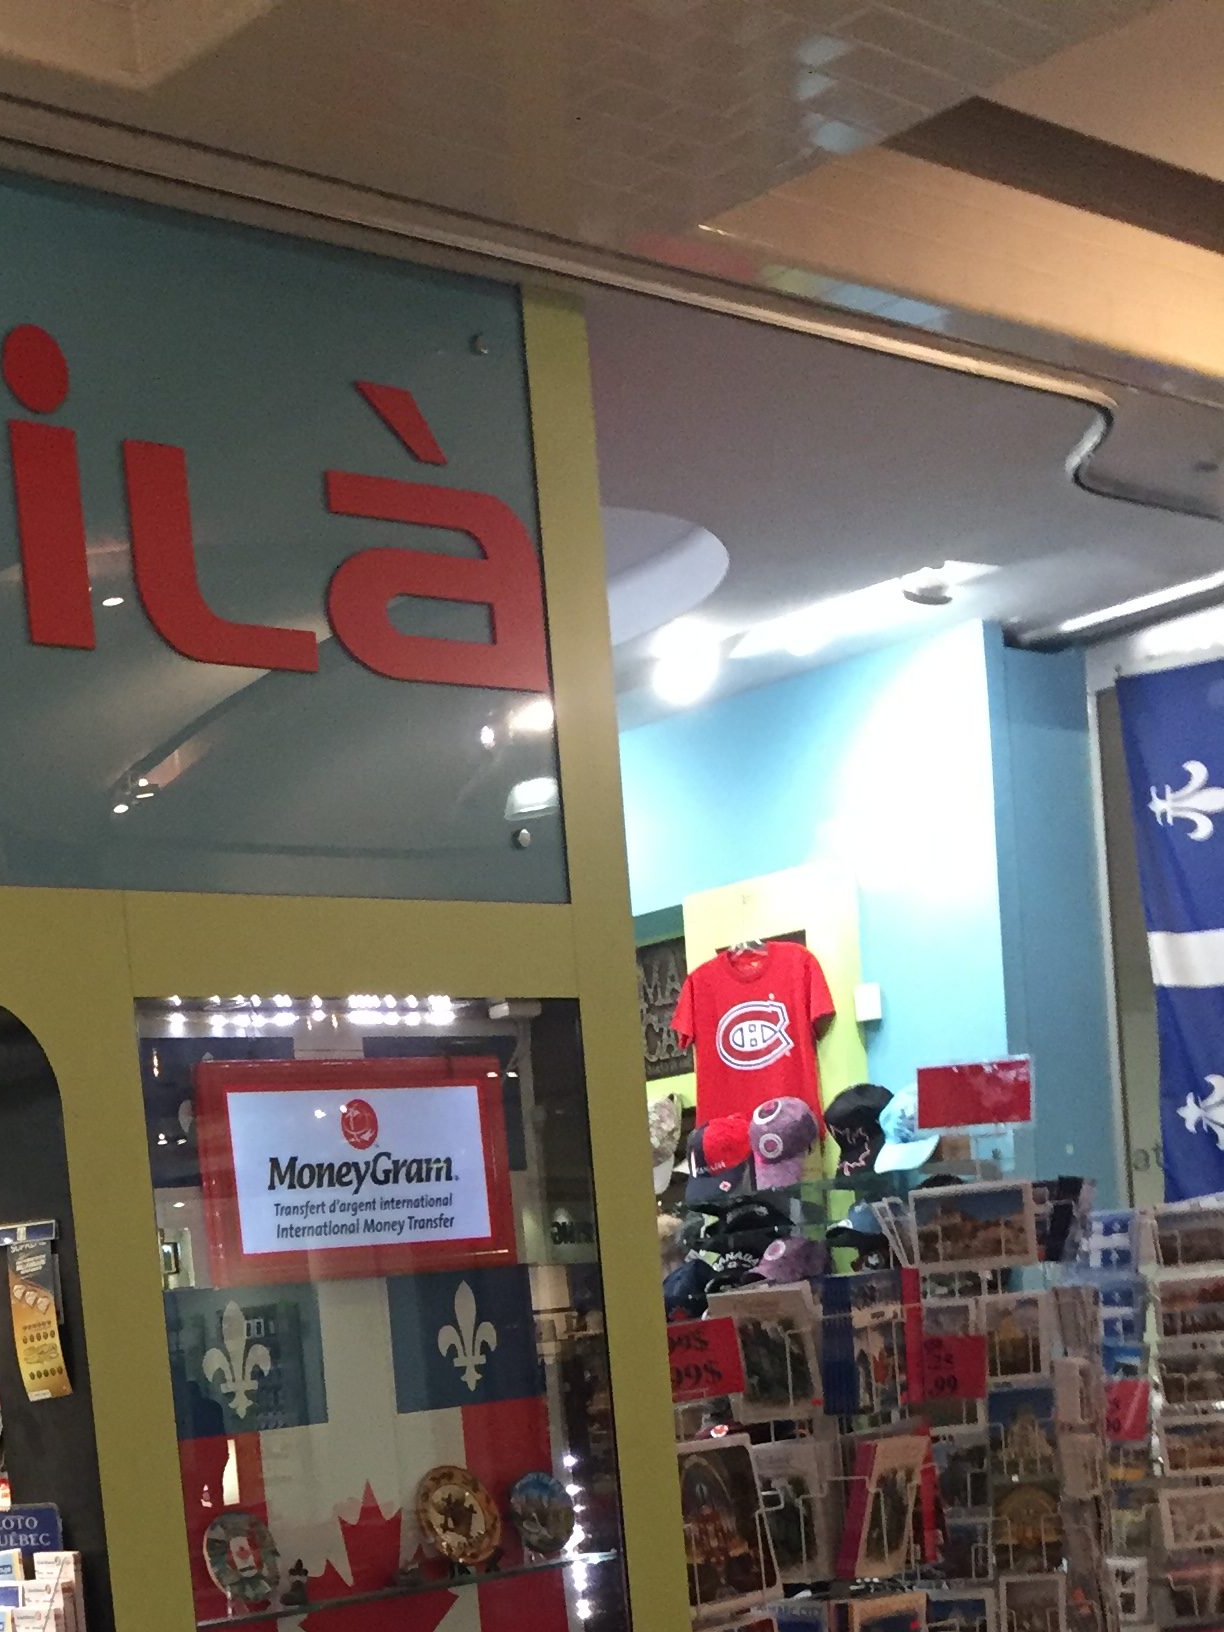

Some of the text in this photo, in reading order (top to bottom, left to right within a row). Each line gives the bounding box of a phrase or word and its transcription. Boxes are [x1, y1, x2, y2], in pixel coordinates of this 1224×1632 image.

[268, 1151, 454, 1195] MoneyGram
[274, 1193, 453, 1219] Transfert d'argent international
[277, 1213, 455, 1239] International Money Transfer
